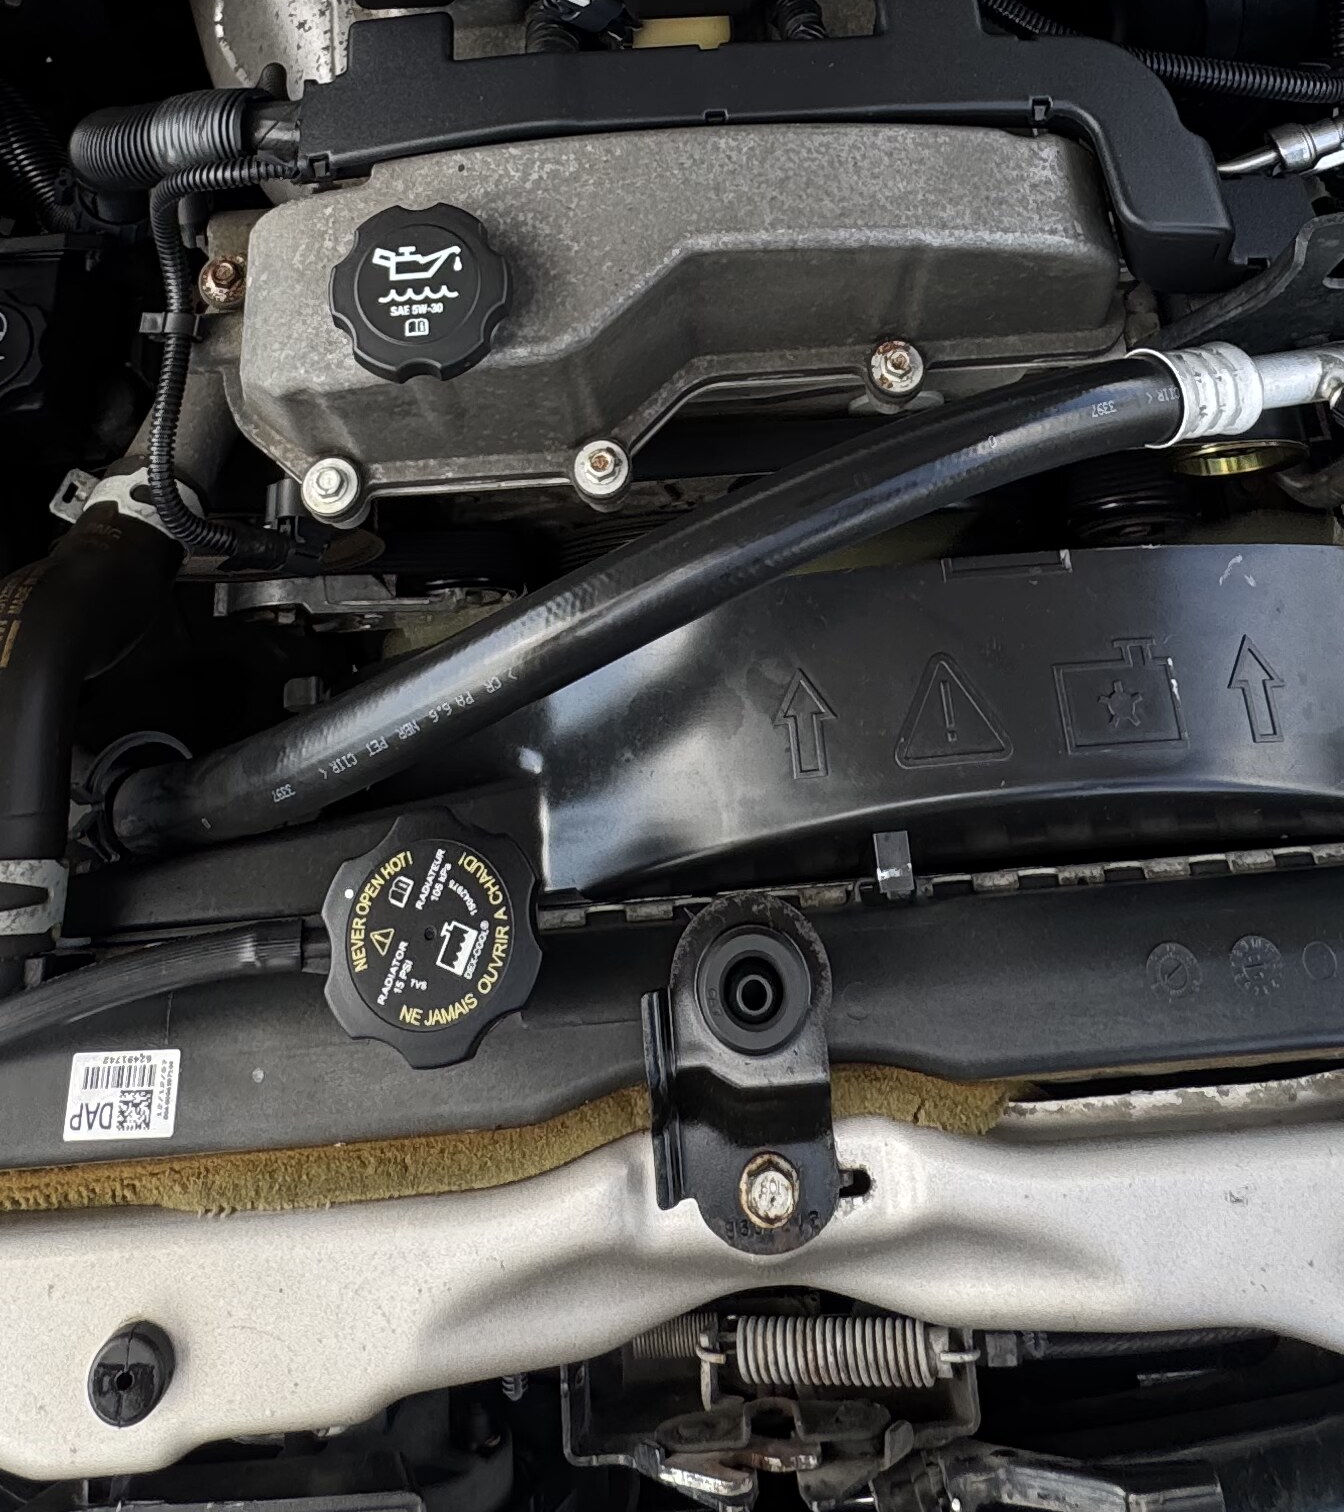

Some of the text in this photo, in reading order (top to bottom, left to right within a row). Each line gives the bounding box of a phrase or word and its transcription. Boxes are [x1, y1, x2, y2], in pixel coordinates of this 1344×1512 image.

[390, 303, 444, 316] SAE 5W-30
[415, 848, 446, 910] RADIATEUR
[351, 851, 414, 973] NEVER OPEN HOT!
[399, 851, 509, 1026] NE JAMAIS OUVRIR A CHAUD!
[377, 941, 409, 1005] RADIATOR
[394, 960, 414, 994] 15 PSI
[69, 1102, 113, 1131] DAP
